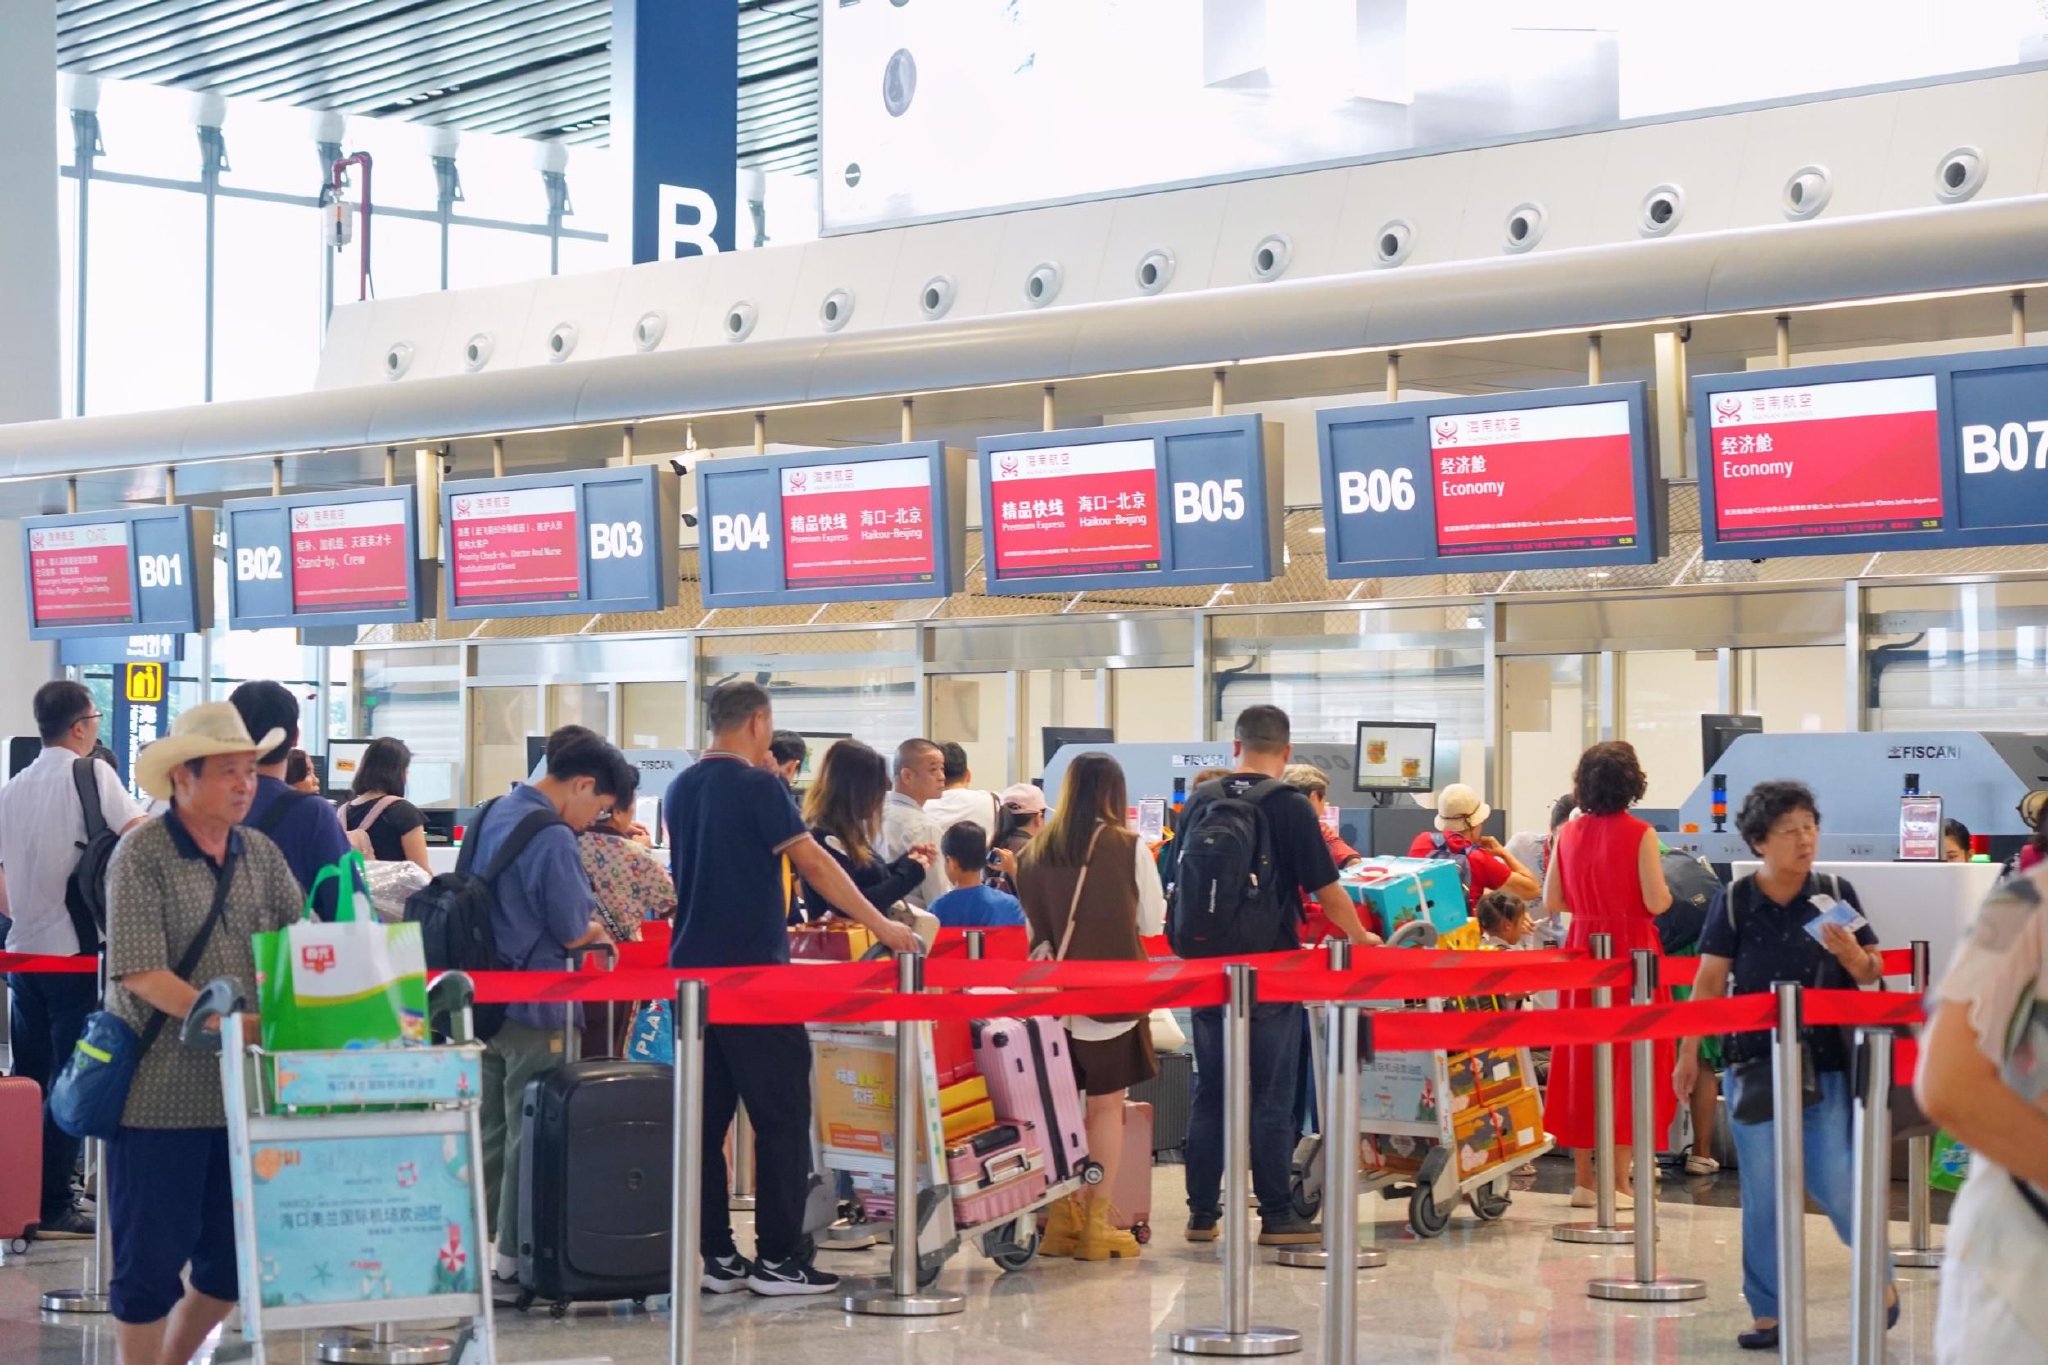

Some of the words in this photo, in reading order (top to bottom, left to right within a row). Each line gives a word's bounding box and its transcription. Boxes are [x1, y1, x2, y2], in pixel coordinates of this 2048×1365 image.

[1721, 433, 1773, 455] 经济舱
[1962, 421, 2048, 474] B07
[1440, 455, 1486, 475] 经济舱
[1723, 461, 1793, 478] Economy
[1339, 467, 1415, 515] B06
[1442, 481, 1505, 497] Economy
[1001, 498, 1064, 520] 精品快线
[1078, 491, 1146, 513] 海口-北京
[1173, 479, 1245, 524] B05
[712, 512, 770, 551] B04
[790, 512, 848, 533] 精品快线
[1002, 523, 1036, 532] Premium
[1037, 520, 1065, 531] Express
[590, 521, 643, 559] B03
[822, 533, 849, 543] Express
[139, 553, 182, 587] B01
[237, 546, 282, 580] B02
[343, 553, 366, 566] Crew
[1184, 754, 1226, 766] FISC
[1903, 746, 1957, 759] FISCAN
[281, 1203, 443, 1229] 海口美兰国际机场欢迎您
